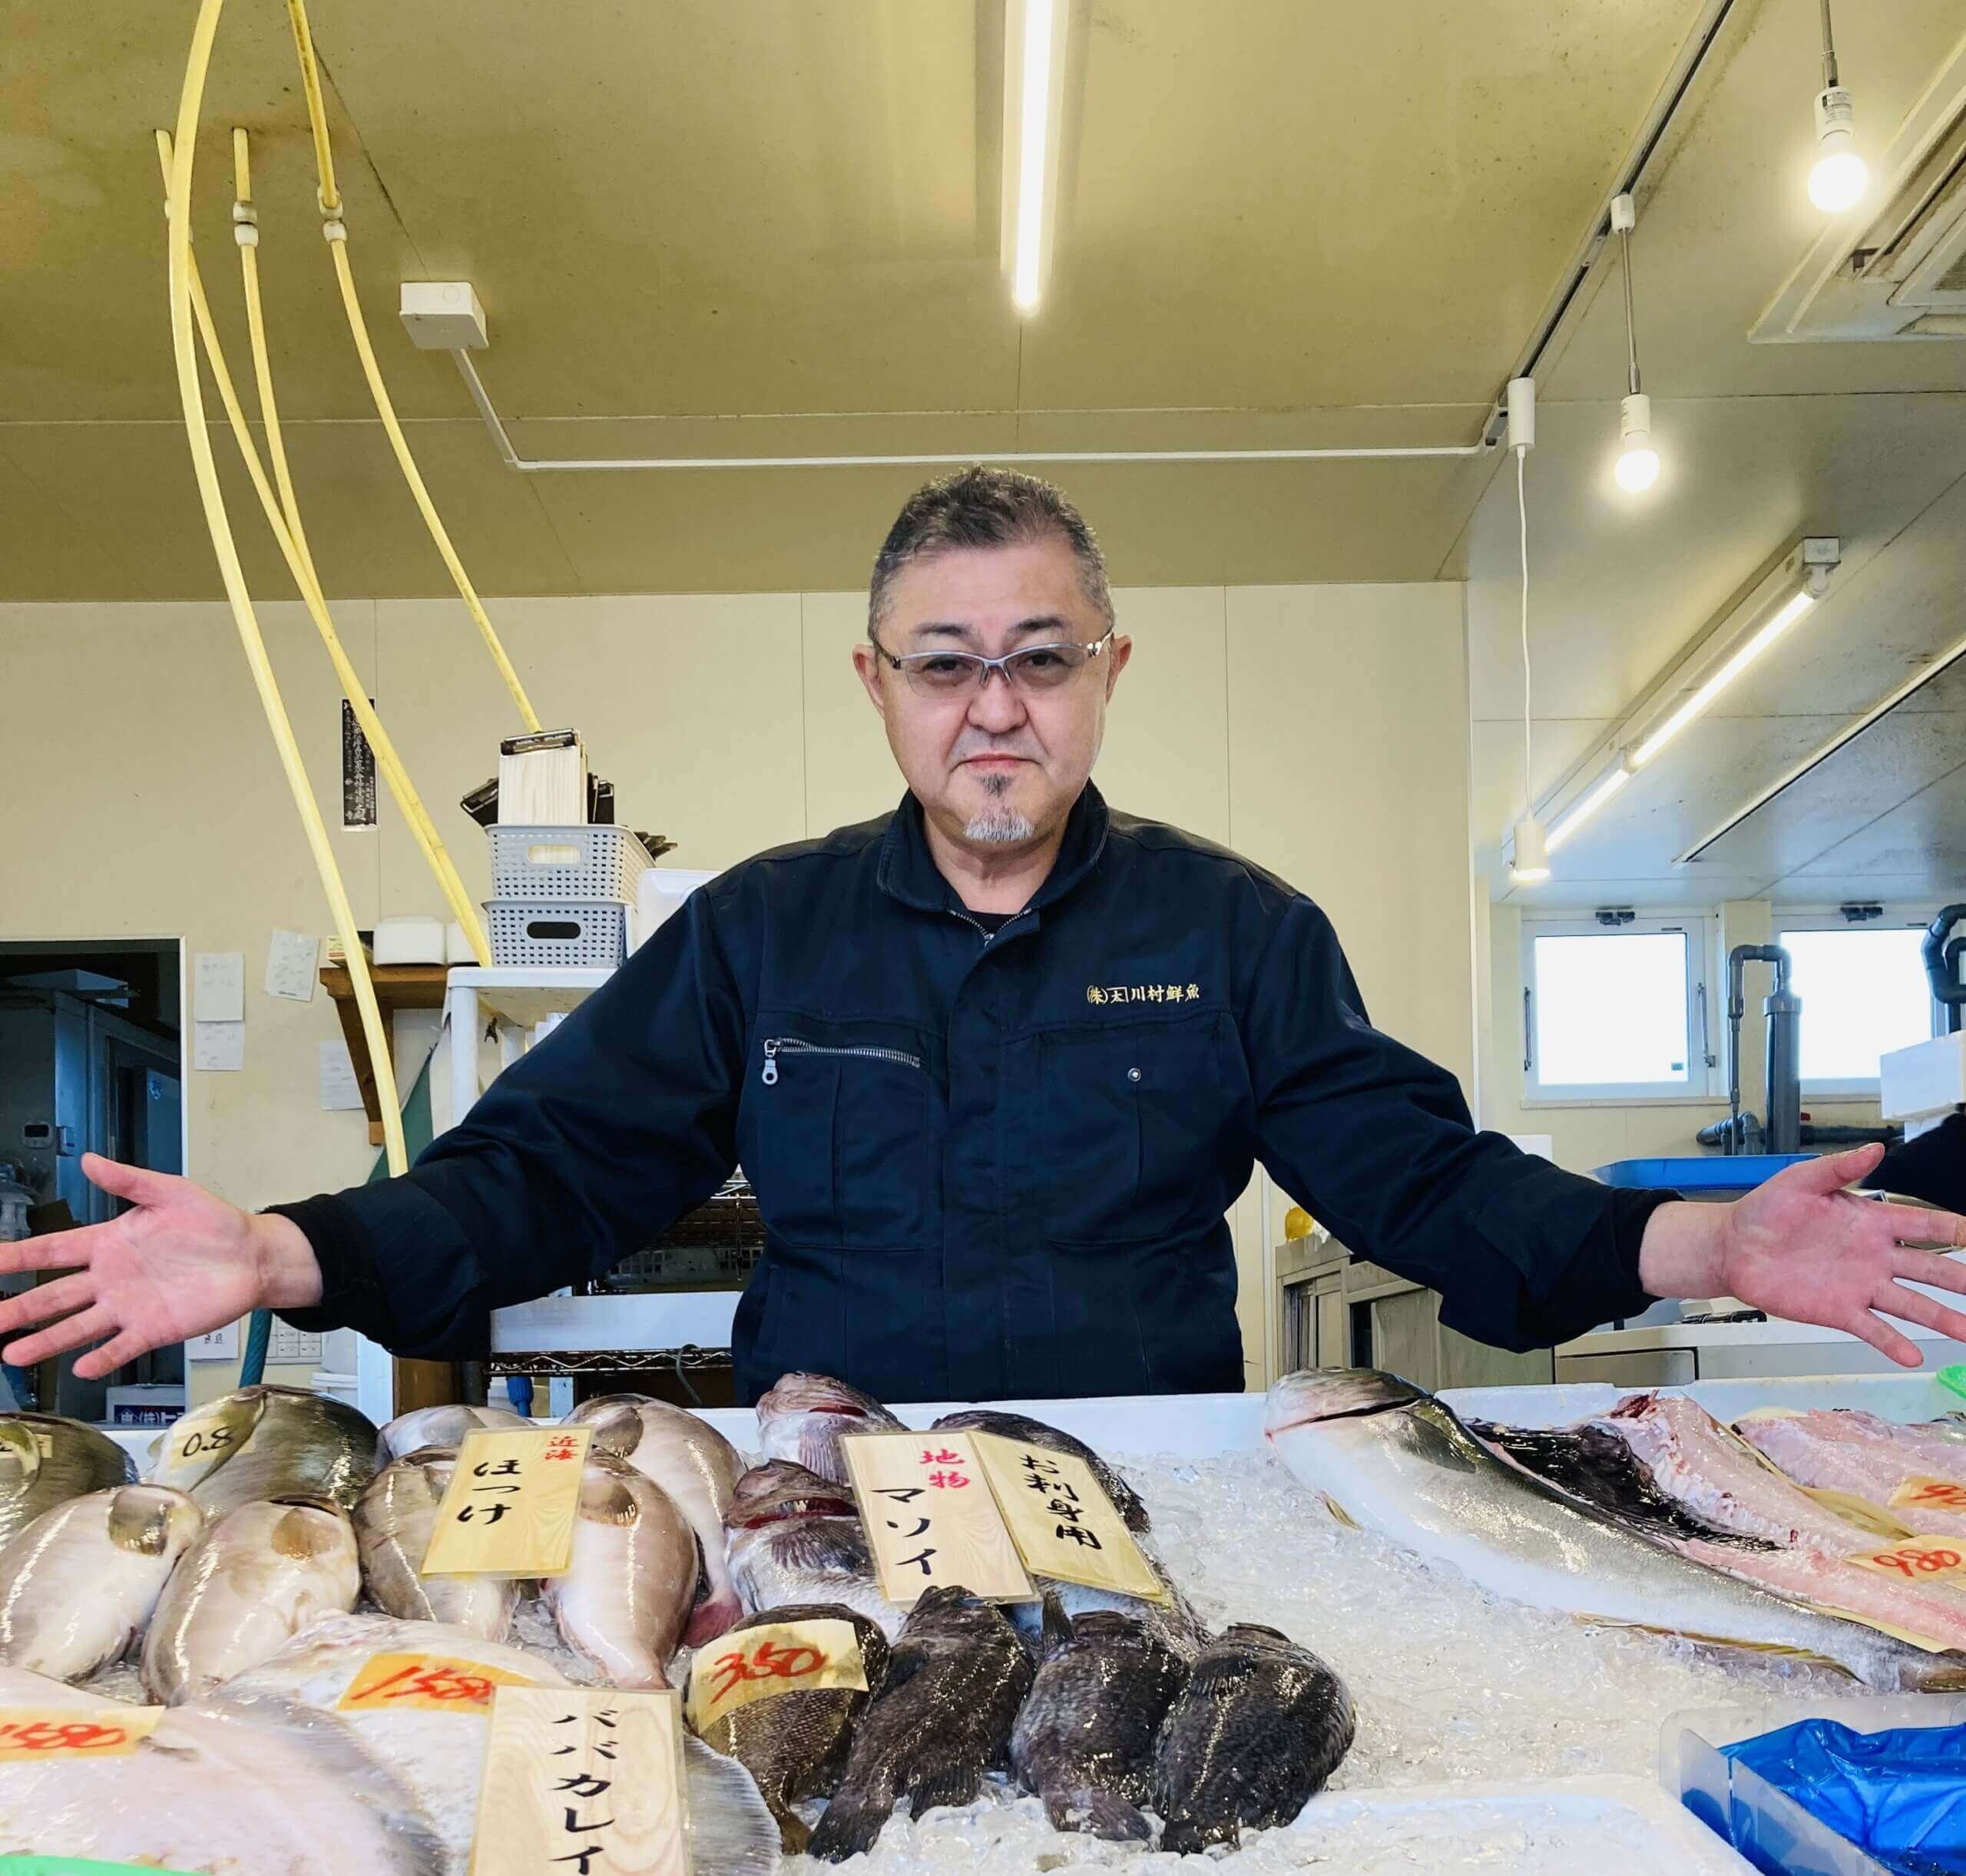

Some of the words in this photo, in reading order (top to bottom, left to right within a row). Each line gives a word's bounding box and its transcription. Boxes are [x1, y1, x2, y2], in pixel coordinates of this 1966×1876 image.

[183, 1426, 234, 1457] 0.8
[544, 1436, 579, 1461] 近海
[919, 1448, 971, 1489] 地物
[1018, 1454, 1102, 1550] お刺身用
[869, 1488, 937, 1575] マソイ
[1872, 1549, 1962, 1577] 980
[710, 1642, 829, 1704] 350
[548, 1709, 620, 1875] ババカレイ
